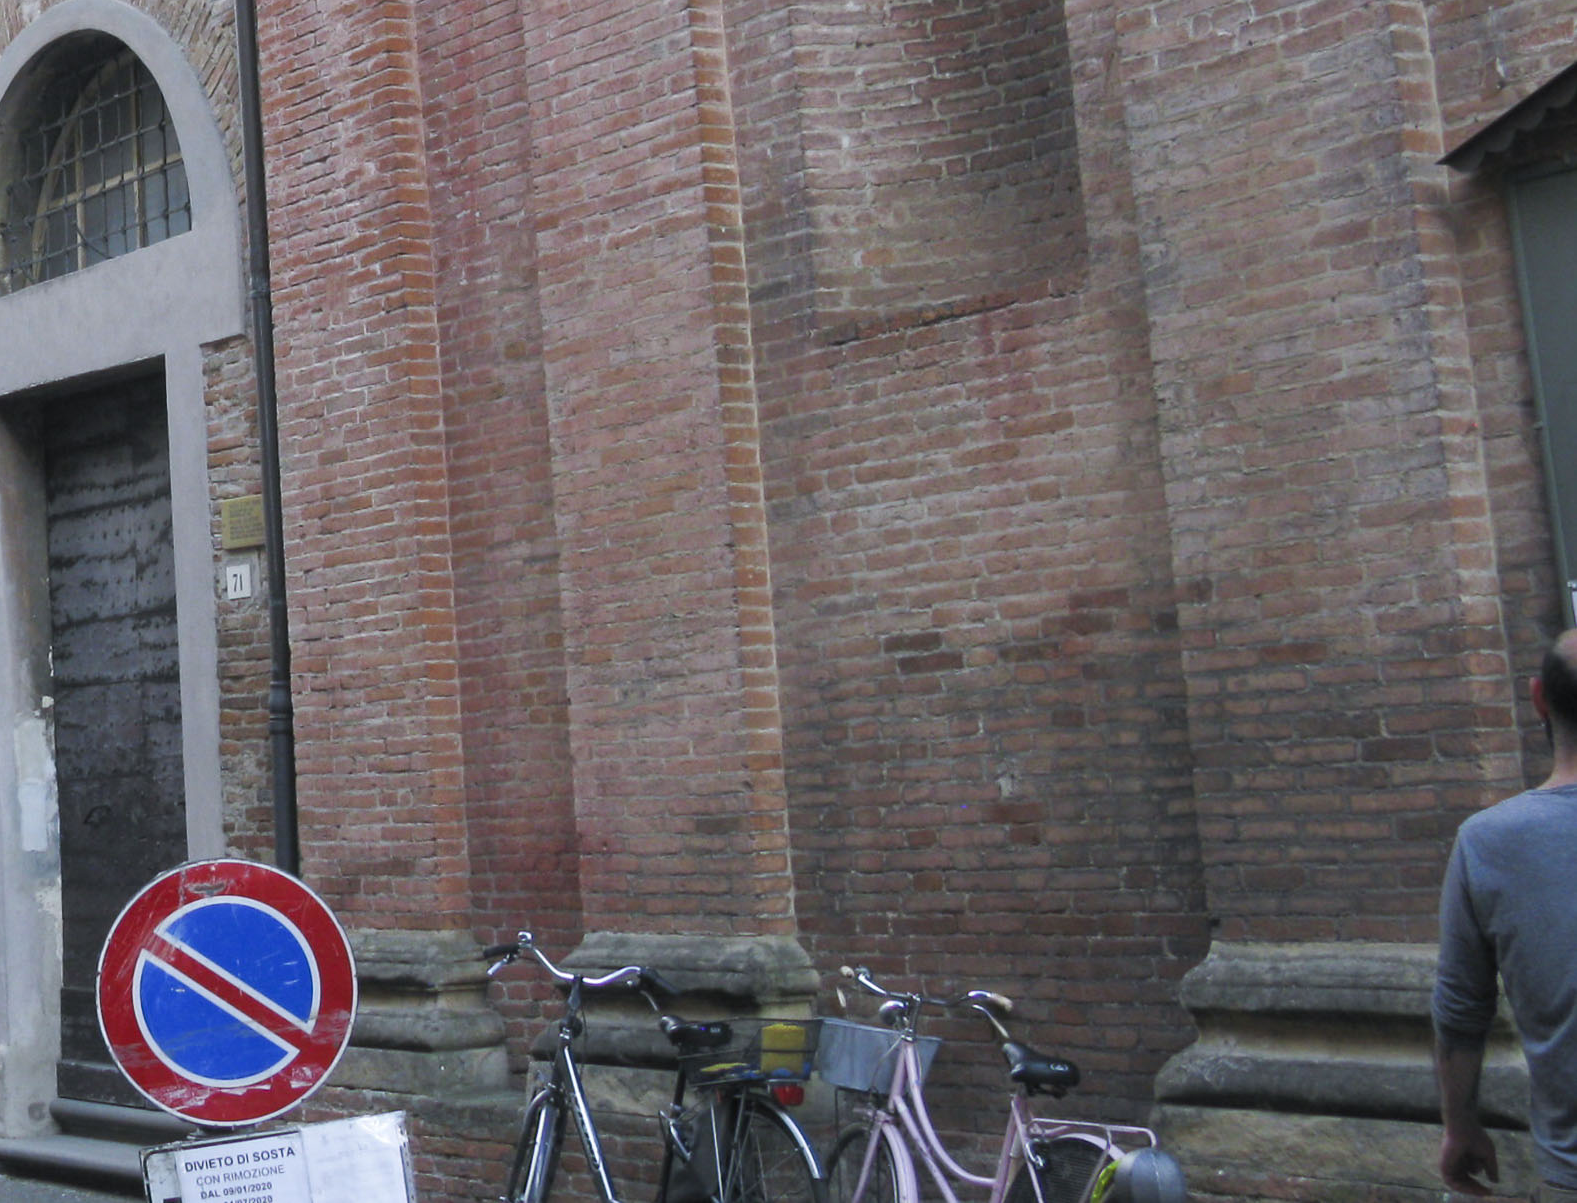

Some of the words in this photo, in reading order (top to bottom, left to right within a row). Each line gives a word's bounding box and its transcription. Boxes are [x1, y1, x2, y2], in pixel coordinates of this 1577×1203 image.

[232, 574, 243, 592] 71
[184, 1156, 233, 1172] DIVIETO
[237, 1153, 249, 1165] DI
[253, 1147, 295, 1162] SOSTA
[196, 1175, 221, 1187] CON
[223, 1164, 285, 1183] RIMOZIONE
[201, 1189, 221, 1199] DAL
[223, 1182, 272, 1196] 09/01/2020
